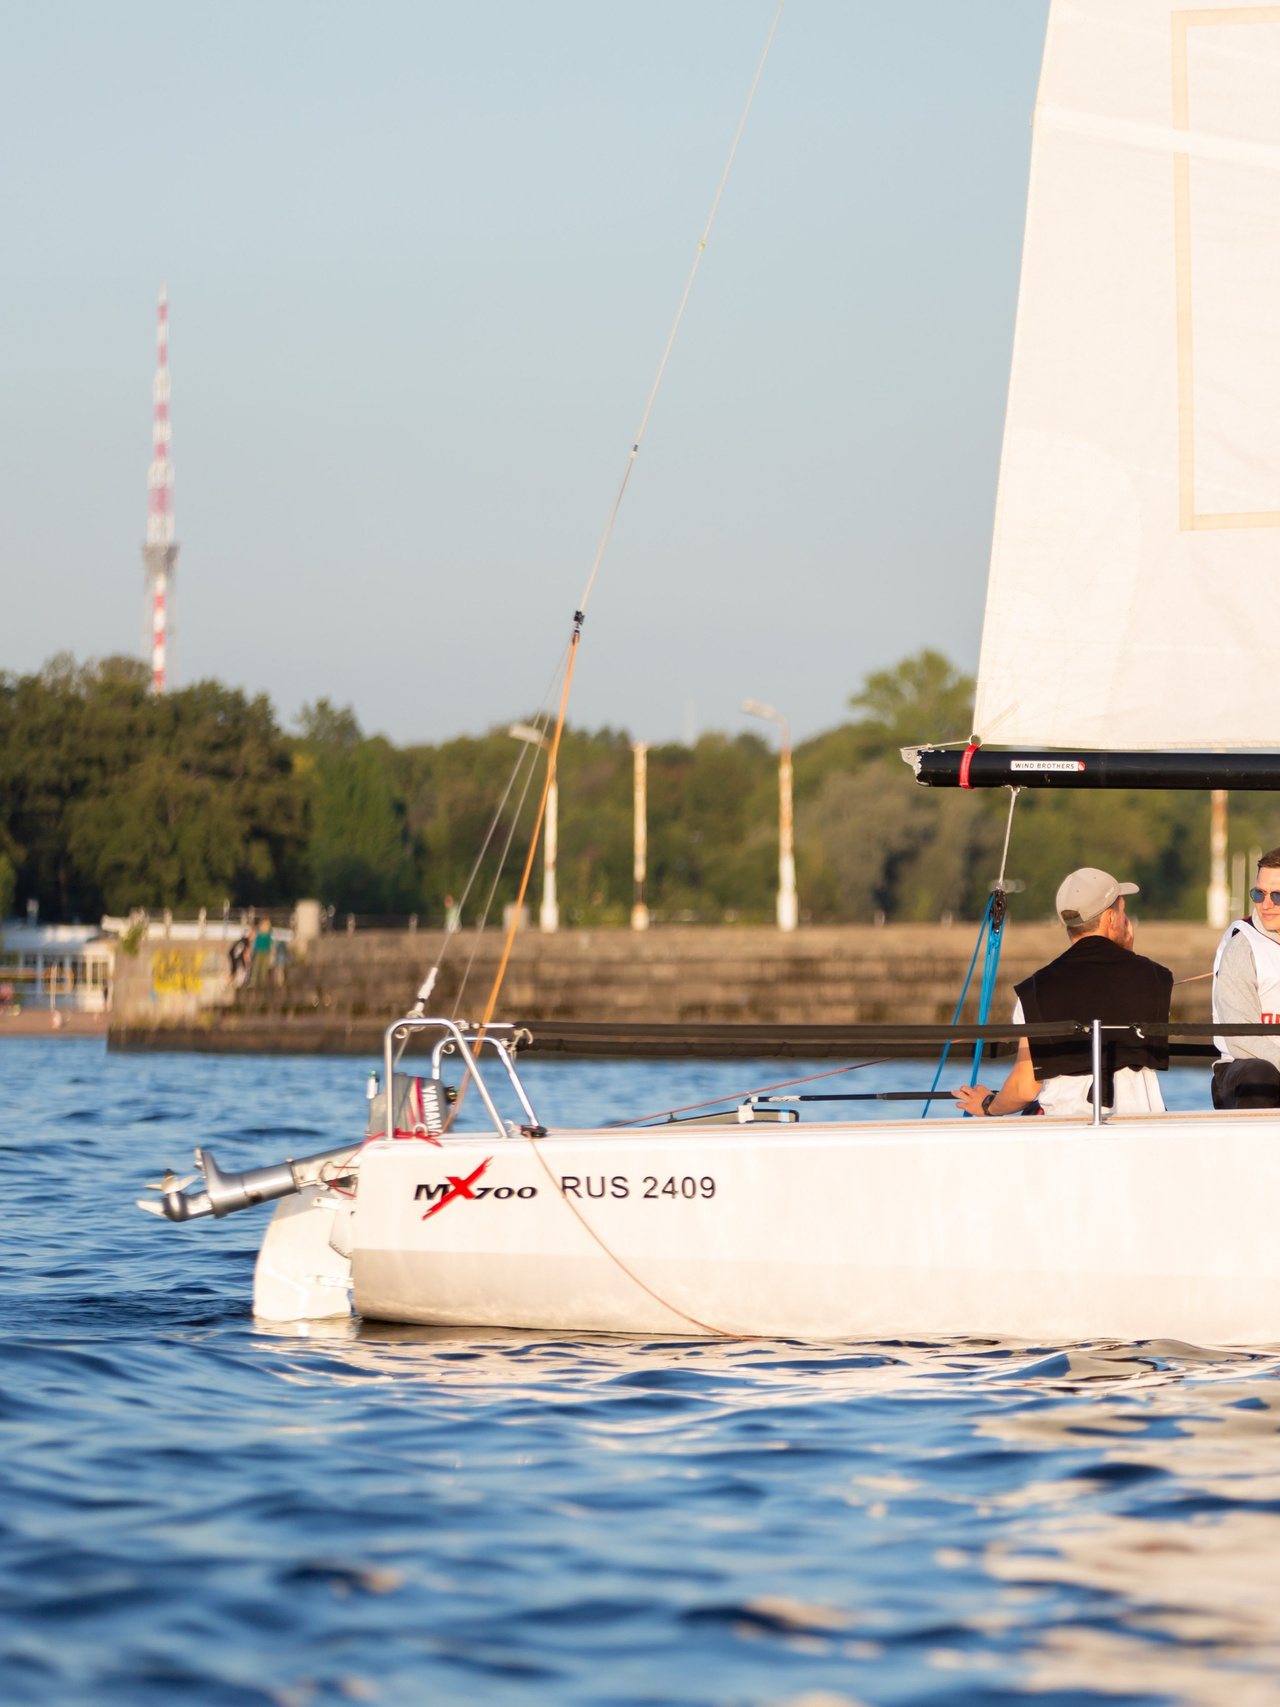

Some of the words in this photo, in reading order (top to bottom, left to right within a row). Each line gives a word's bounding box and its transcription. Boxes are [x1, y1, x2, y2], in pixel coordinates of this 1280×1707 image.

[1036, 762, 1075, 770] BROTHERS
[561, 1176, 630, 1199] RUS
[642, 1176, 716, 1199] 2409
